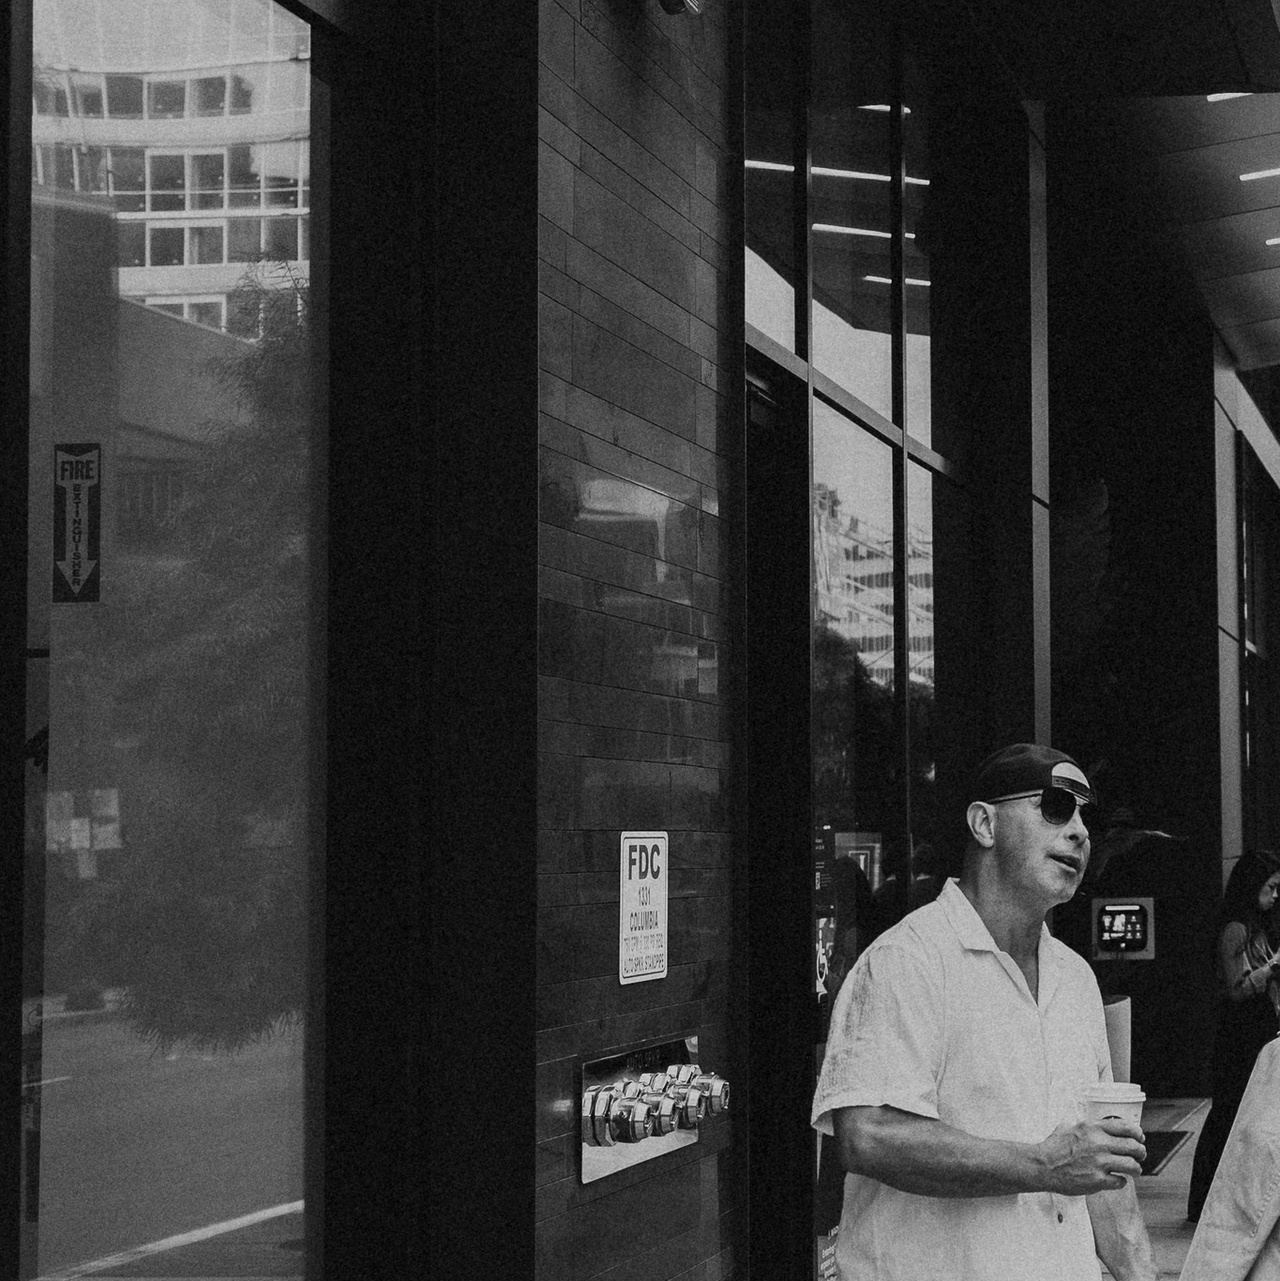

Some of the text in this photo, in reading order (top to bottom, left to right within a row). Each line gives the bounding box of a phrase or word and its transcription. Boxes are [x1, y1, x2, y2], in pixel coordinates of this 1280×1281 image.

[60, 459, 95, 481] FIRE
[72, 483, 82, 586] EXTINGUISHER
[628, 843, 661, 881] FDC
[629, 910, 659, 932] COLUMBIA
